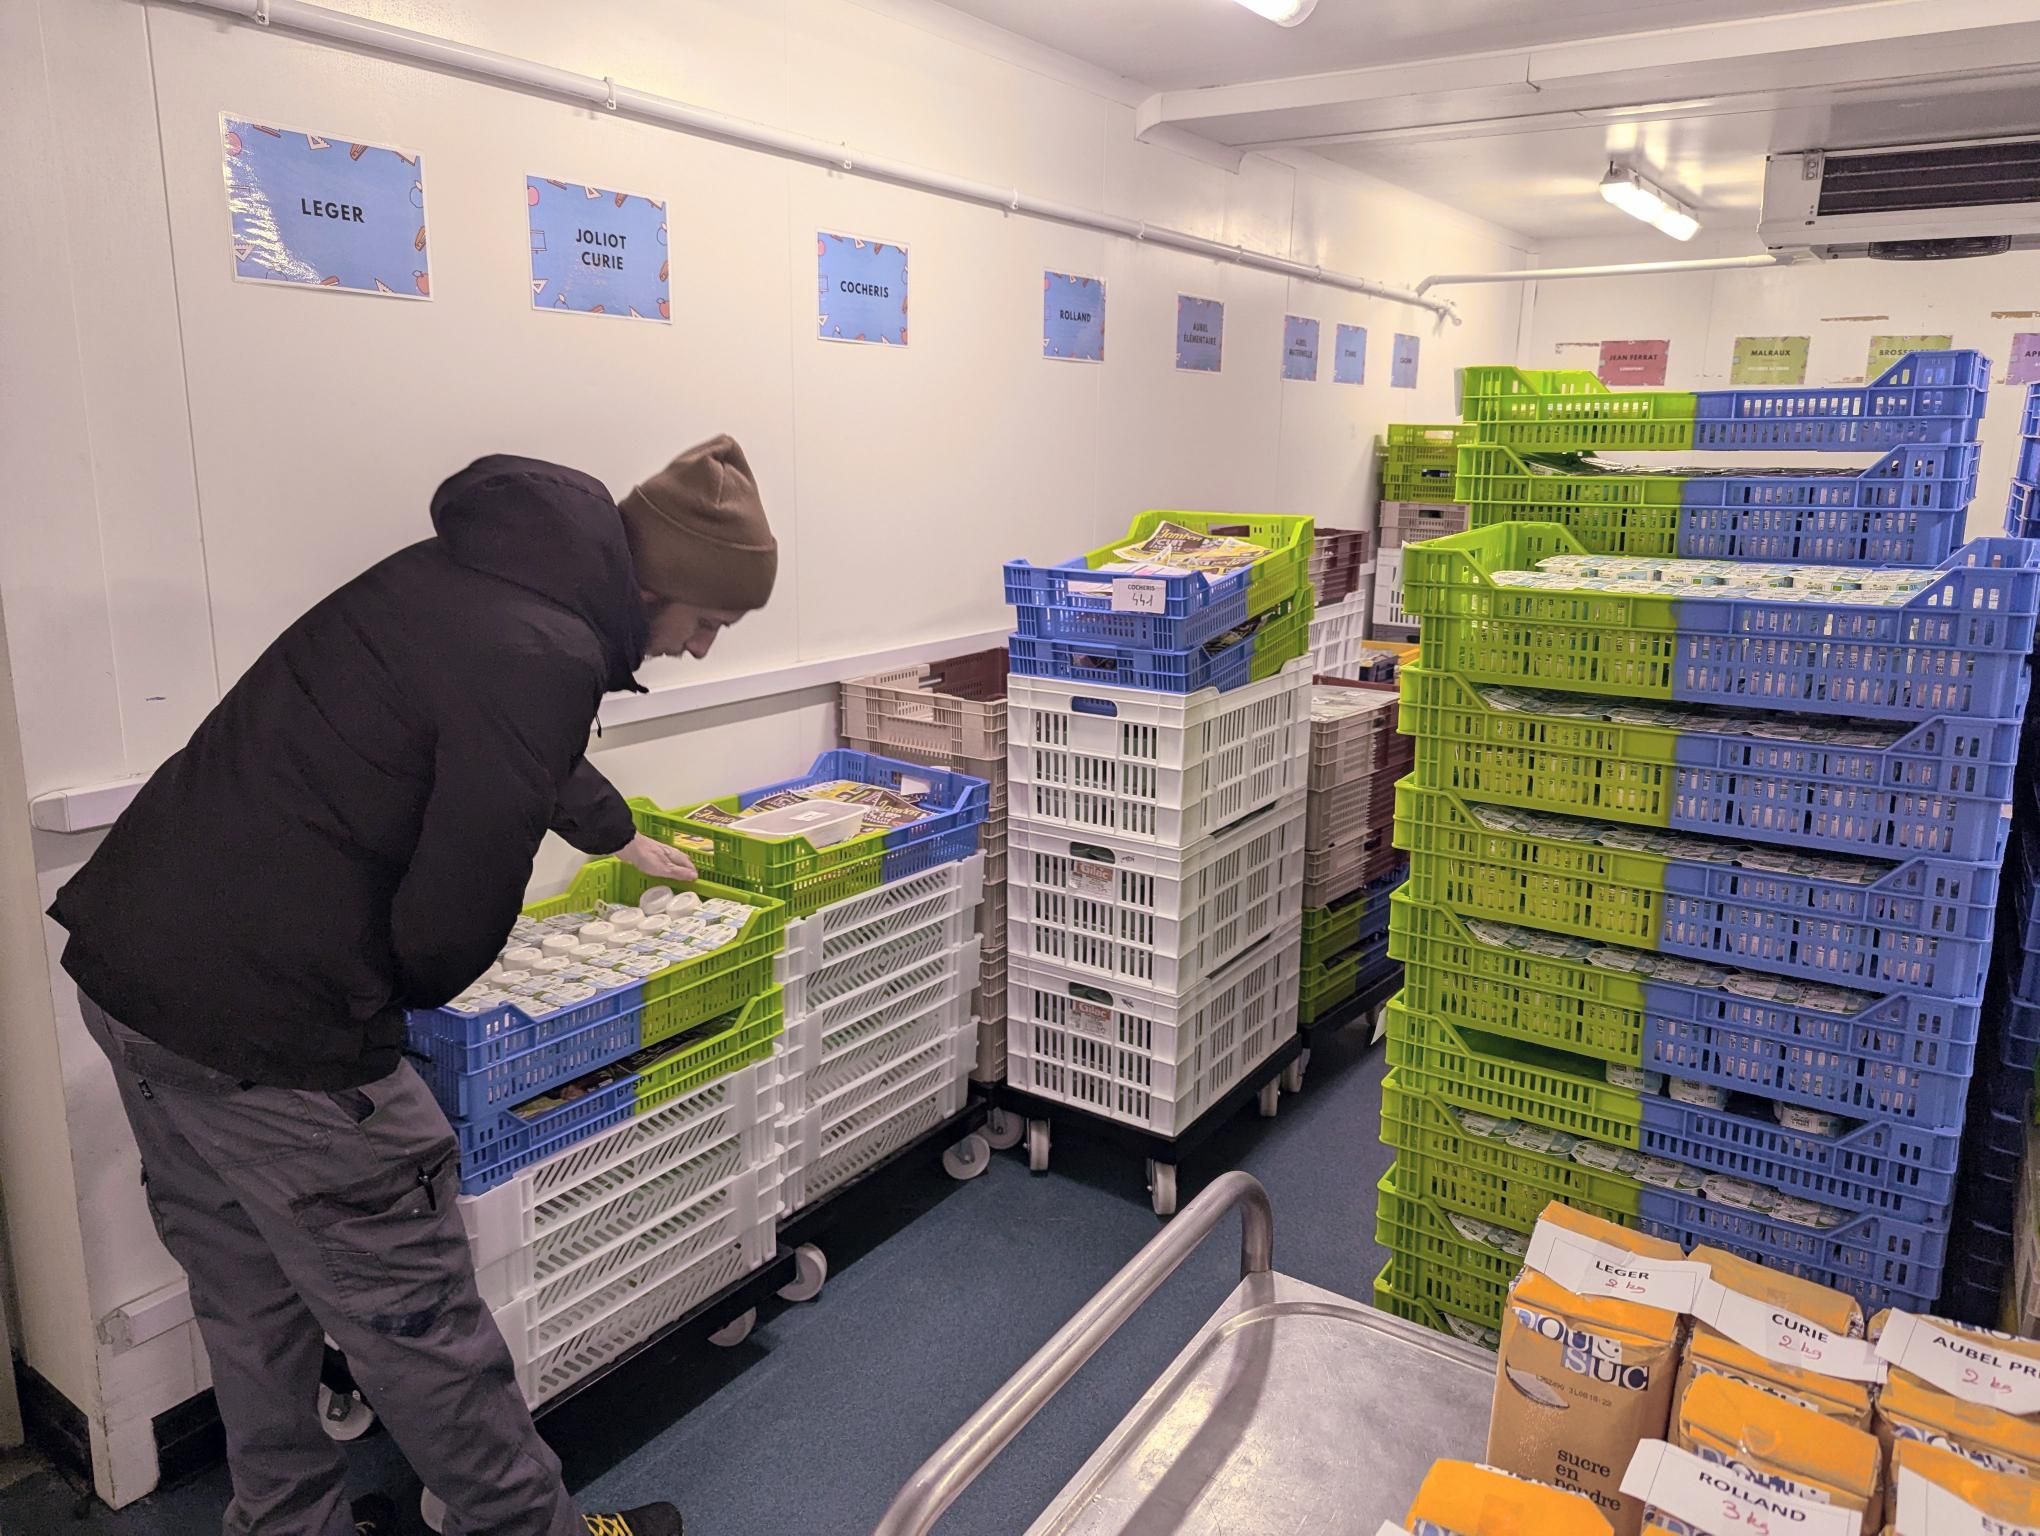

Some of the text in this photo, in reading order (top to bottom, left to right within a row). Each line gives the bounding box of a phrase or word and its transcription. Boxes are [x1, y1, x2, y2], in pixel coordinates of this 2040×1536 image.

[301, 197, 365, 224] LEGER
[575, 228, 627, 250] JOLIOT
[581, 251, 624, 271] CURIE
[840, 280, 889, 299] COCHERIS
[1059, 309, 1092, 323] ROLLAND
[1630, 353, 1658, 361] FERRAT
[1751, 349, 1791, 357] MALRAUX
[1127, 583, 1156, 592] COCHERIS
[1596, 1260, 1650, 1280] LEGER
[1605, 1278, 1618, 1289] 2
[1772, 1313, 1829, 1344] CURIE
[1778, 1334, 1822, 1360] 2 kg
[1932, 1335, 2003, 1369] AUBEL
[1565, 1347, 1648, 1391] SUC
[1962, 1367, 1979, 1385] 2
[1555, 1463, 1579, 1482] en
[1557, 1449, 1611, 1478] sucre
[1698, 1471, 1807, 1523] ROLLAND
[1722, 1499, 1741, 1521] 3
[1746, 1511, 1770, 1536] kg
